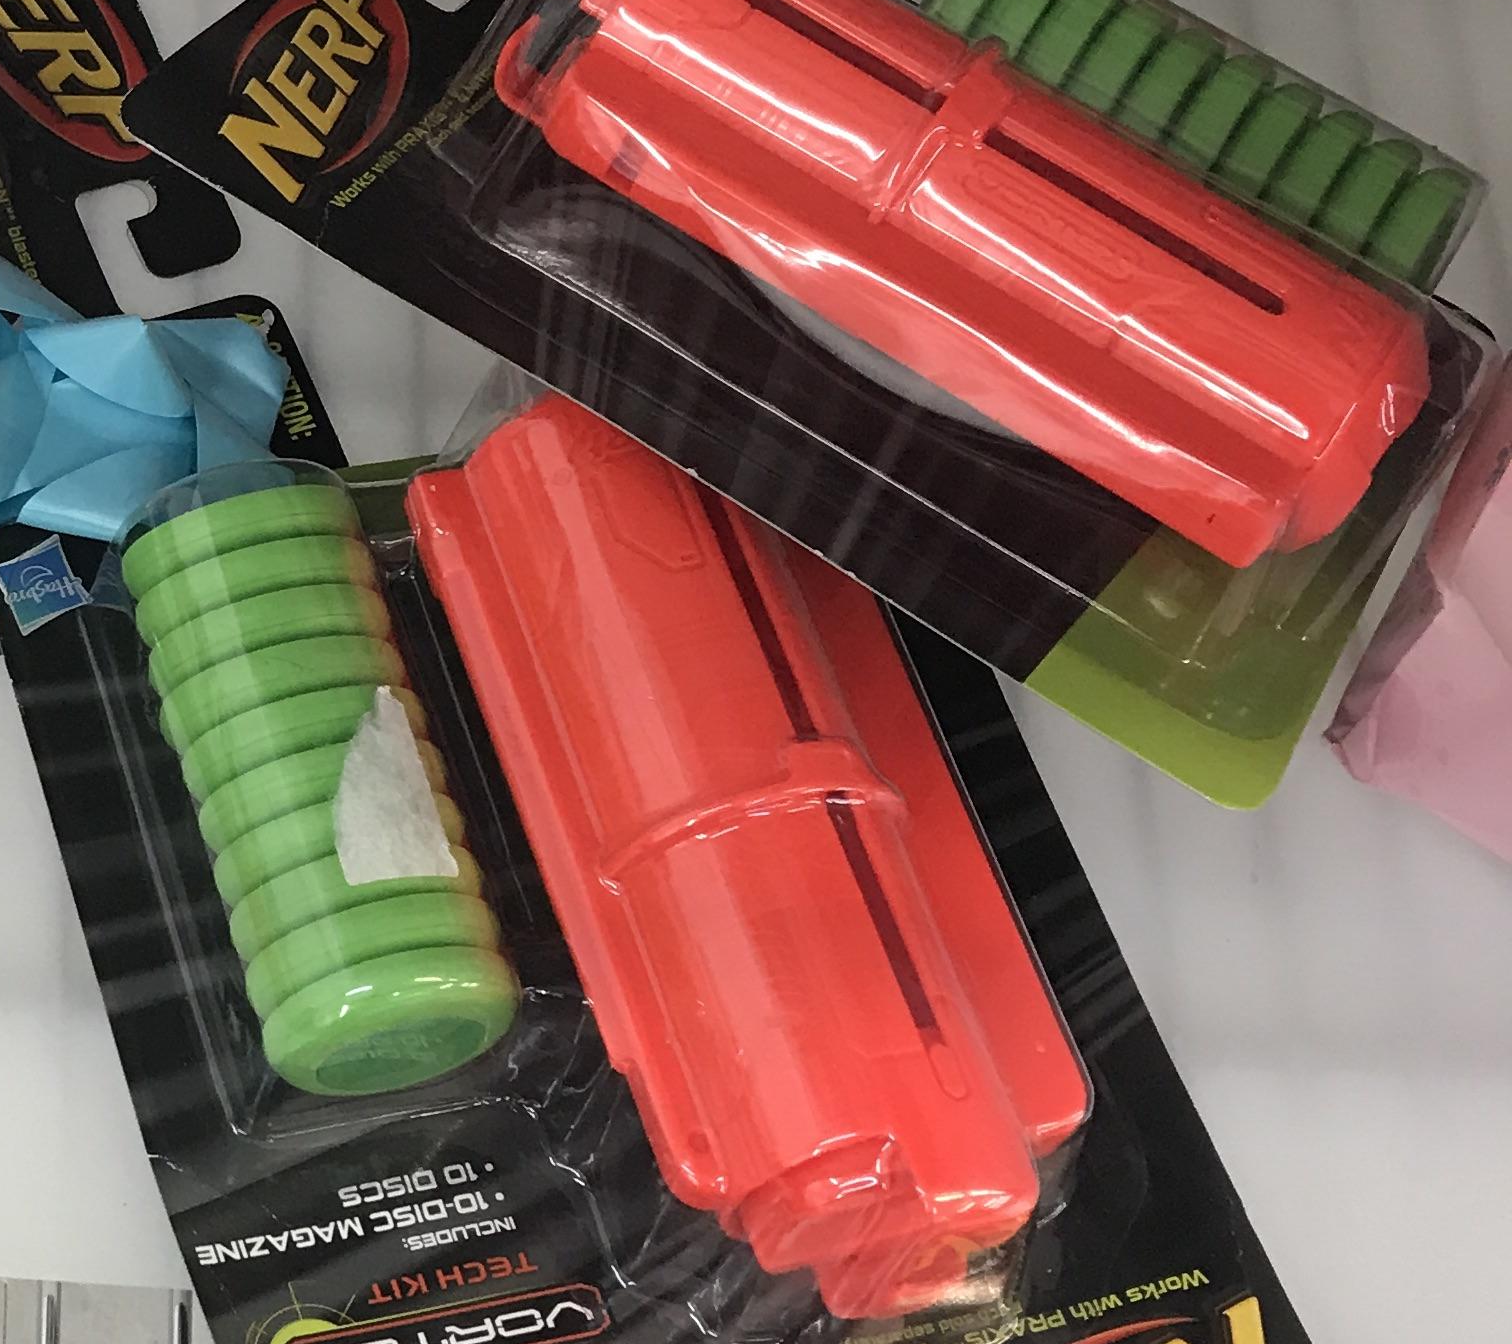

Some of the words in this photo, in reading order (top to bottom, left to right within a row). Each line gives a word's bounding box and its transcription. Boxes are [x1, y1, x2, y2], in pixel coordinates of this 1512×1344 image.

[328, 166, 377, 213] Works
[1, 565, 87, 620] Hasbro
[336, 1165, 436, 1208] DISCS
[443, 1159, 479, 1185] 10
[368, 1187, 489, 1232] 10-DISC
[193, 1213, 362, 1266] MAGAZINE
[401, 1214, 516, 1252] INCLUDES:
[364, 1271, 427, 1304] KIT
[434, 1248, 538, 1290] TECH
[1124, 1264, 1209, 1307] Works
[937, 1313, 973, 1332] sold
[1067, 1291, 1120, 1324] with
